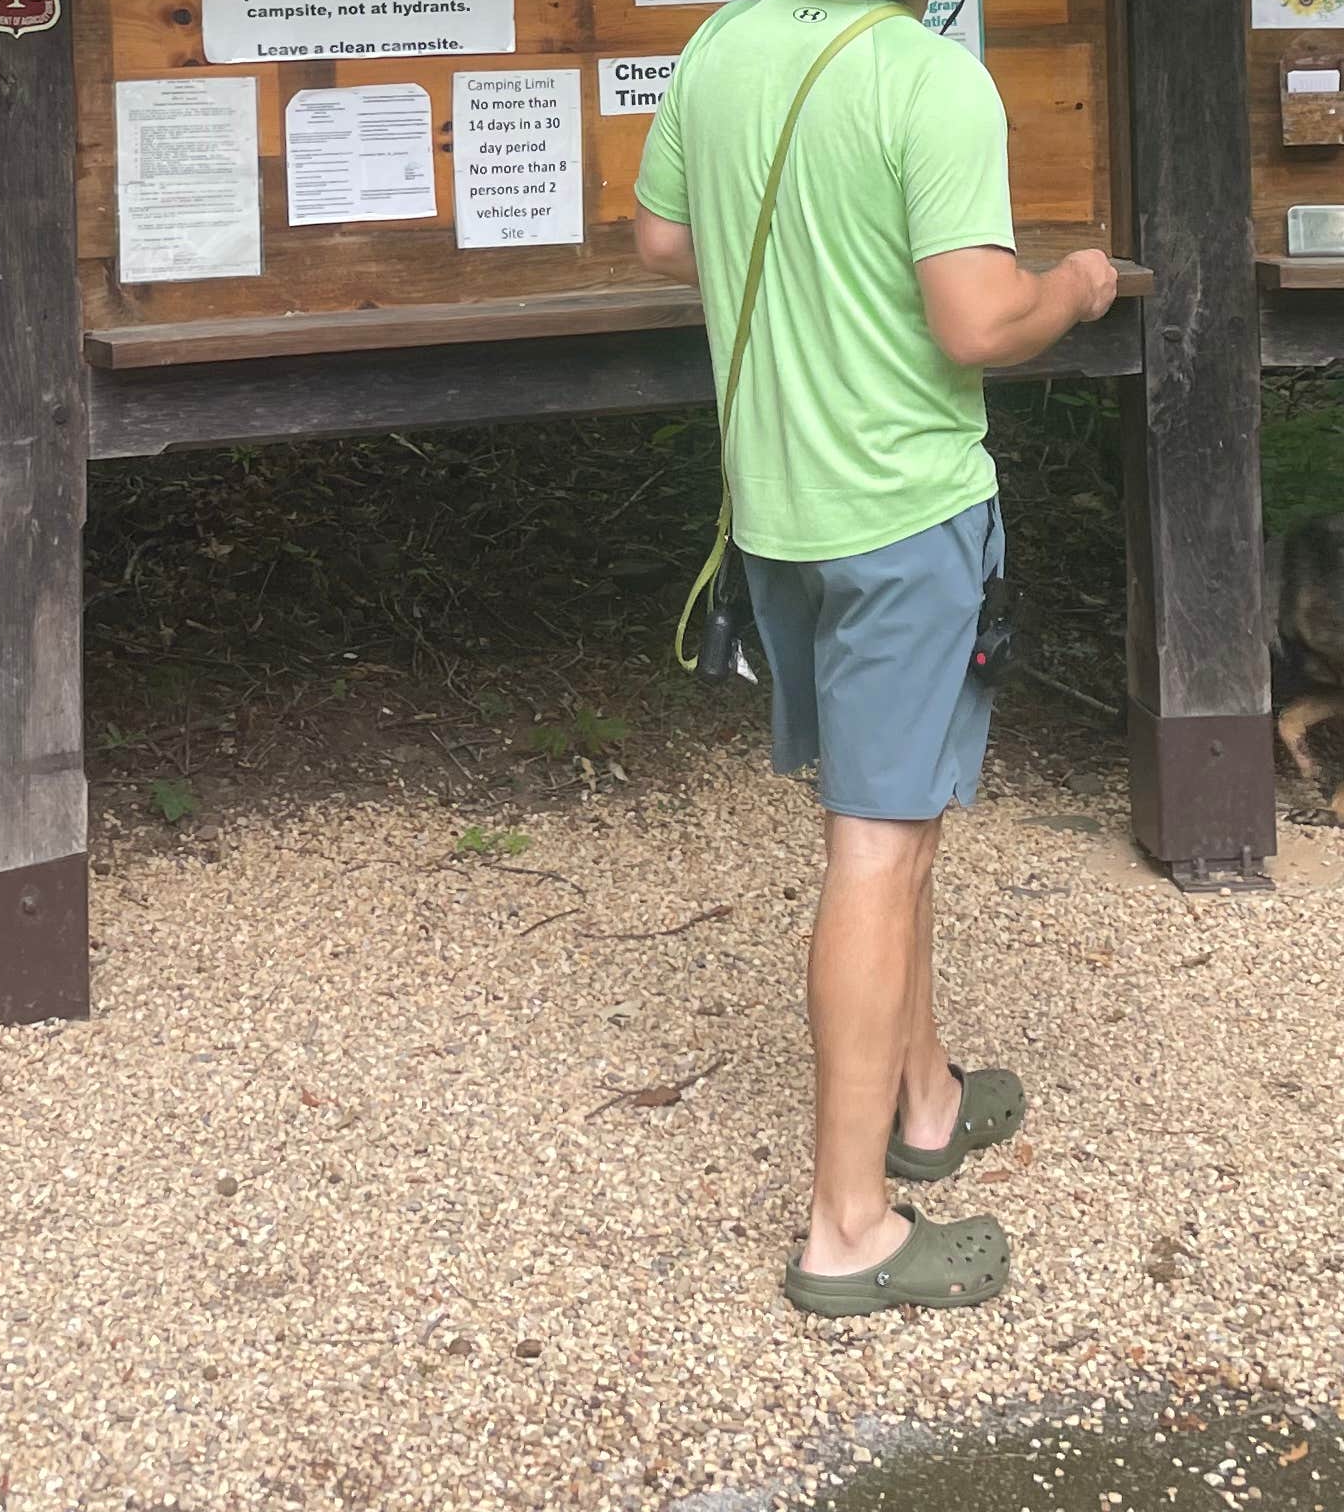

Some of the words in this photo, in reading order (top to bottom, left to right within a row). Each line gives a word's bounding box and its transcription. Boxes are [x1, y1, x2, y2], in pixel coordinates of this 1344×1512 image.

[247, 4, 333, 21] campsite,
[338, 3, 365, 16] not
[371, 3, 388, 15] at
[392, 0, 471, 17] hydrants.
[257, 44, 308, 57] Leave
[314, 46, 323, 55] a
[329, 40, 375, 54] clean
[380, 38, 464, 55] campsite.
[467, 79, 521, 93] Camping
[525, 78, 555, 90] Limit
[470, 98, 489, 110] No
[493, 99, 525, 109] more
[529, 97, 557, 108] than
[469, 119, 484, 131] 14
[487, 118, 516, 133] days
[519, 118, 531, 129] in
[534, 120, 542, 130] a
[545, 118, 561, 129] 30
[479, 141, 502, 156] day
[506, 140, 546, 155] period
[470, 164, 487, 175] No
[491, 164, 524, 174] more
[528, 162, 556, 173] than
[559, 161, 567, 172] 8
[470, 184, 519, 199] persons
[522, 183, 545, 194] and
[549, 182, 557, 193] 2
[477, 207, 527, 219] vehicles
[530, 206, 552, 219] per
[501, 228, 524, 239] Site
